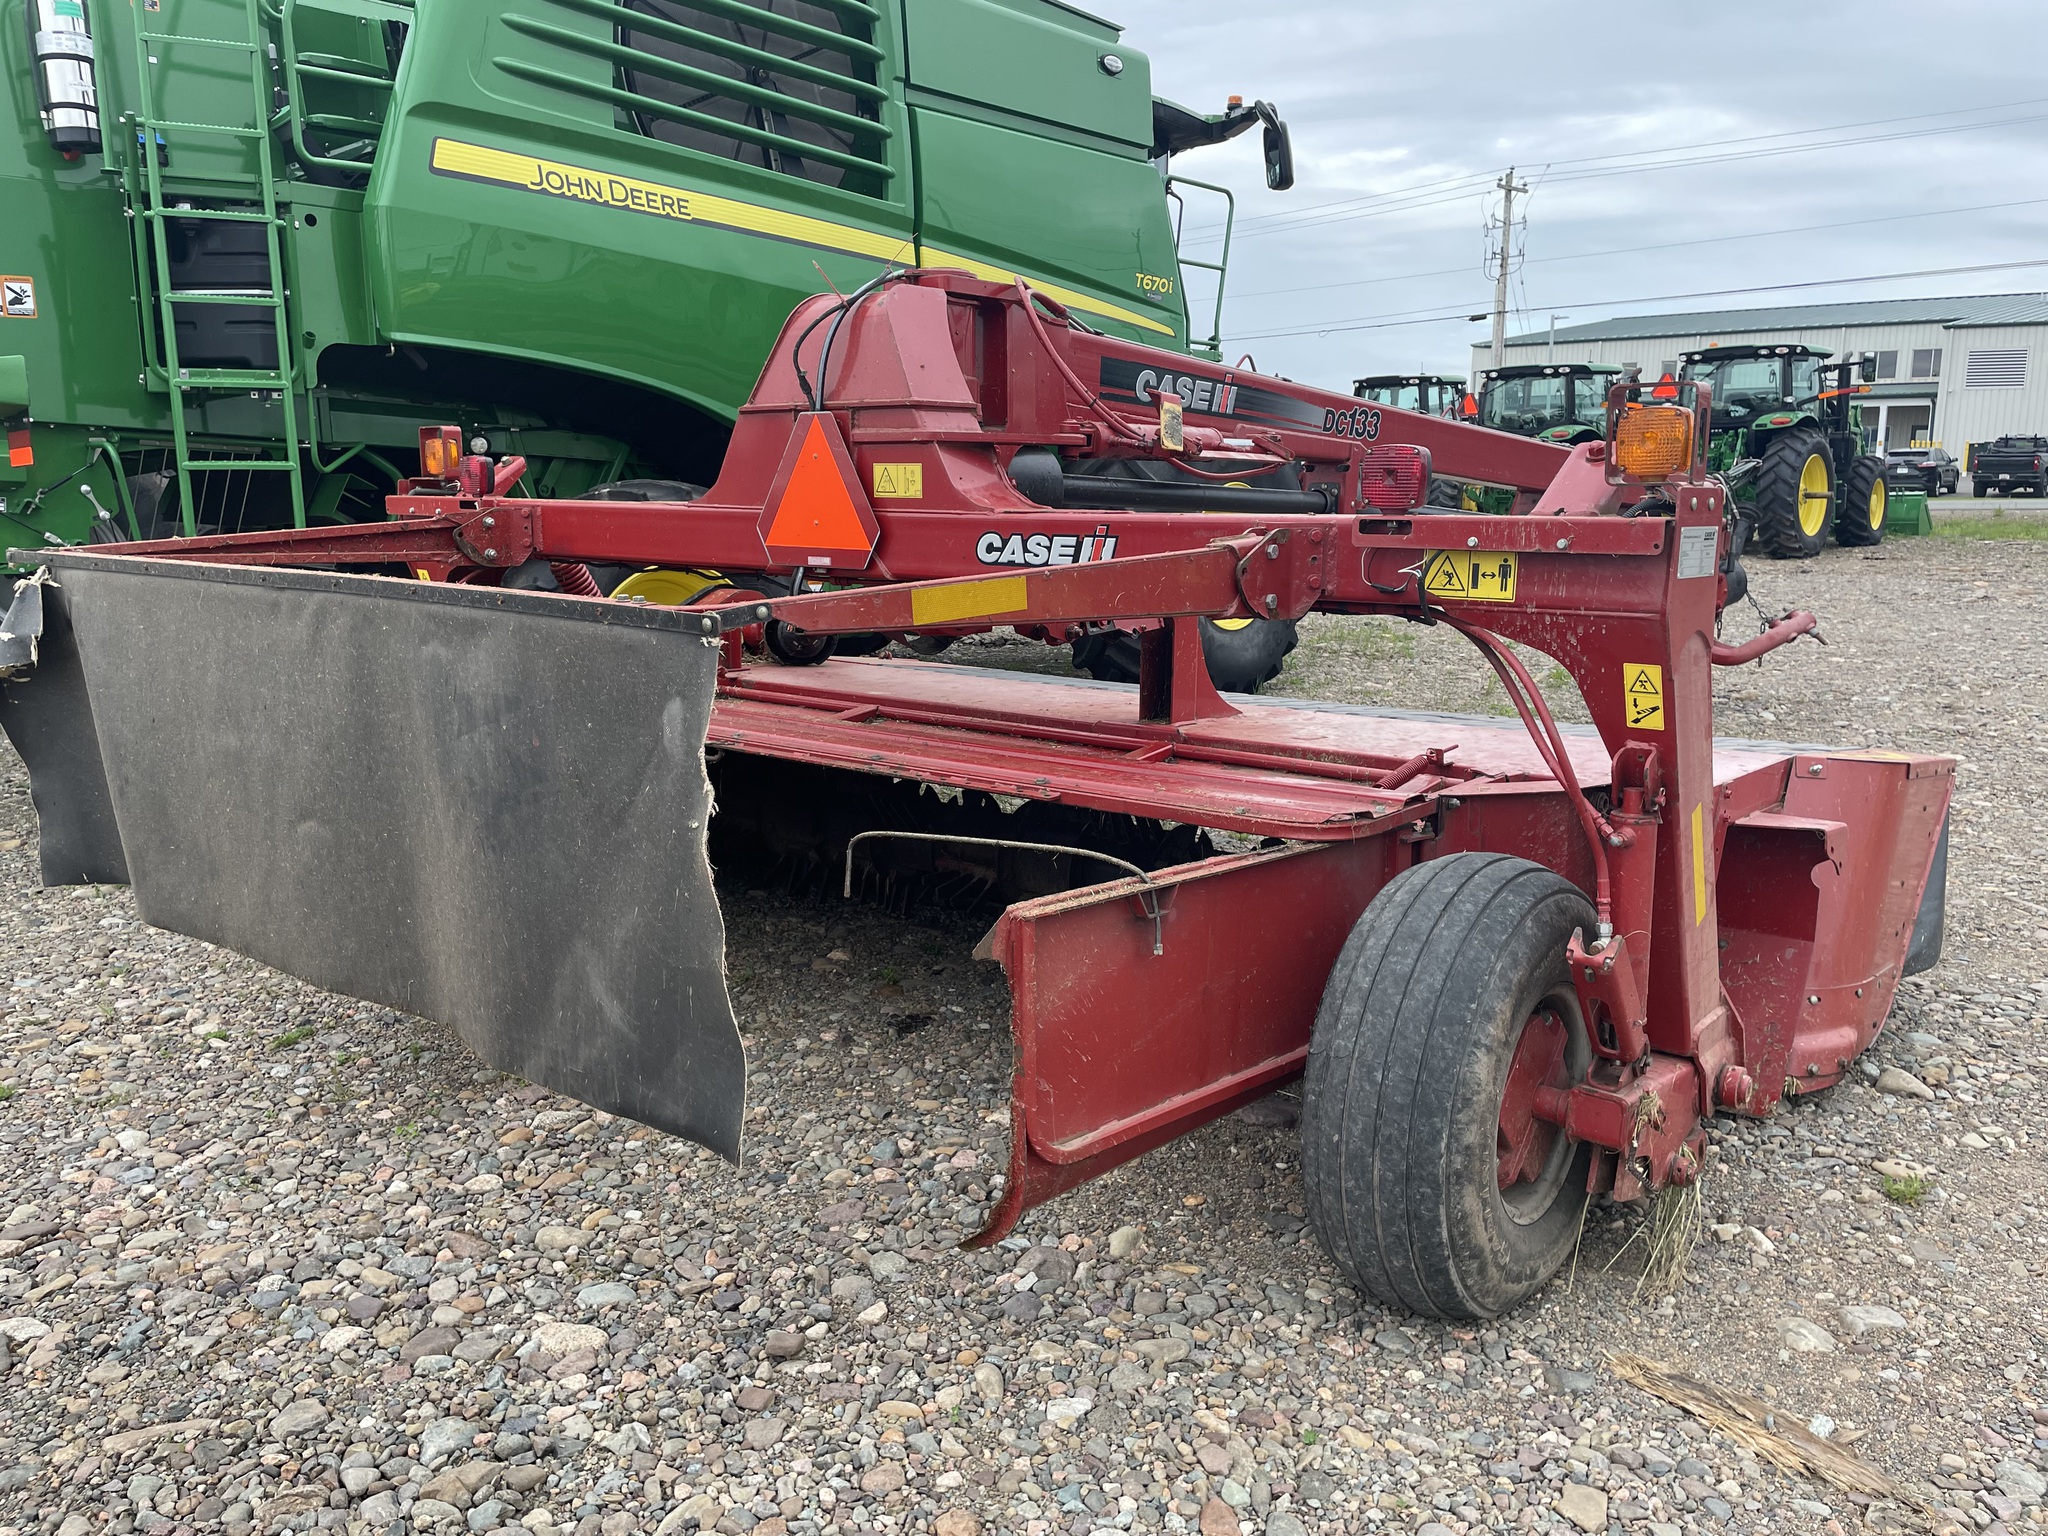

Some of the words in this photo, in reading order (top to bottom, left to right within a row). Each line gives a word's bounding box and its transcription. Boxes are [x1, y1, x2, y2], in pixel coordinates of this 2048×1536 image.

[529, 164, 603, 200] JOHN
[608, 178, 692, 217] DEERE
[1135, 272, 1174, 294] T670i
[1135, 369, 1213, 411] CASE
[1321, 406, 1381, 441] DC133
[976, 532, 1078, 566] CASE
